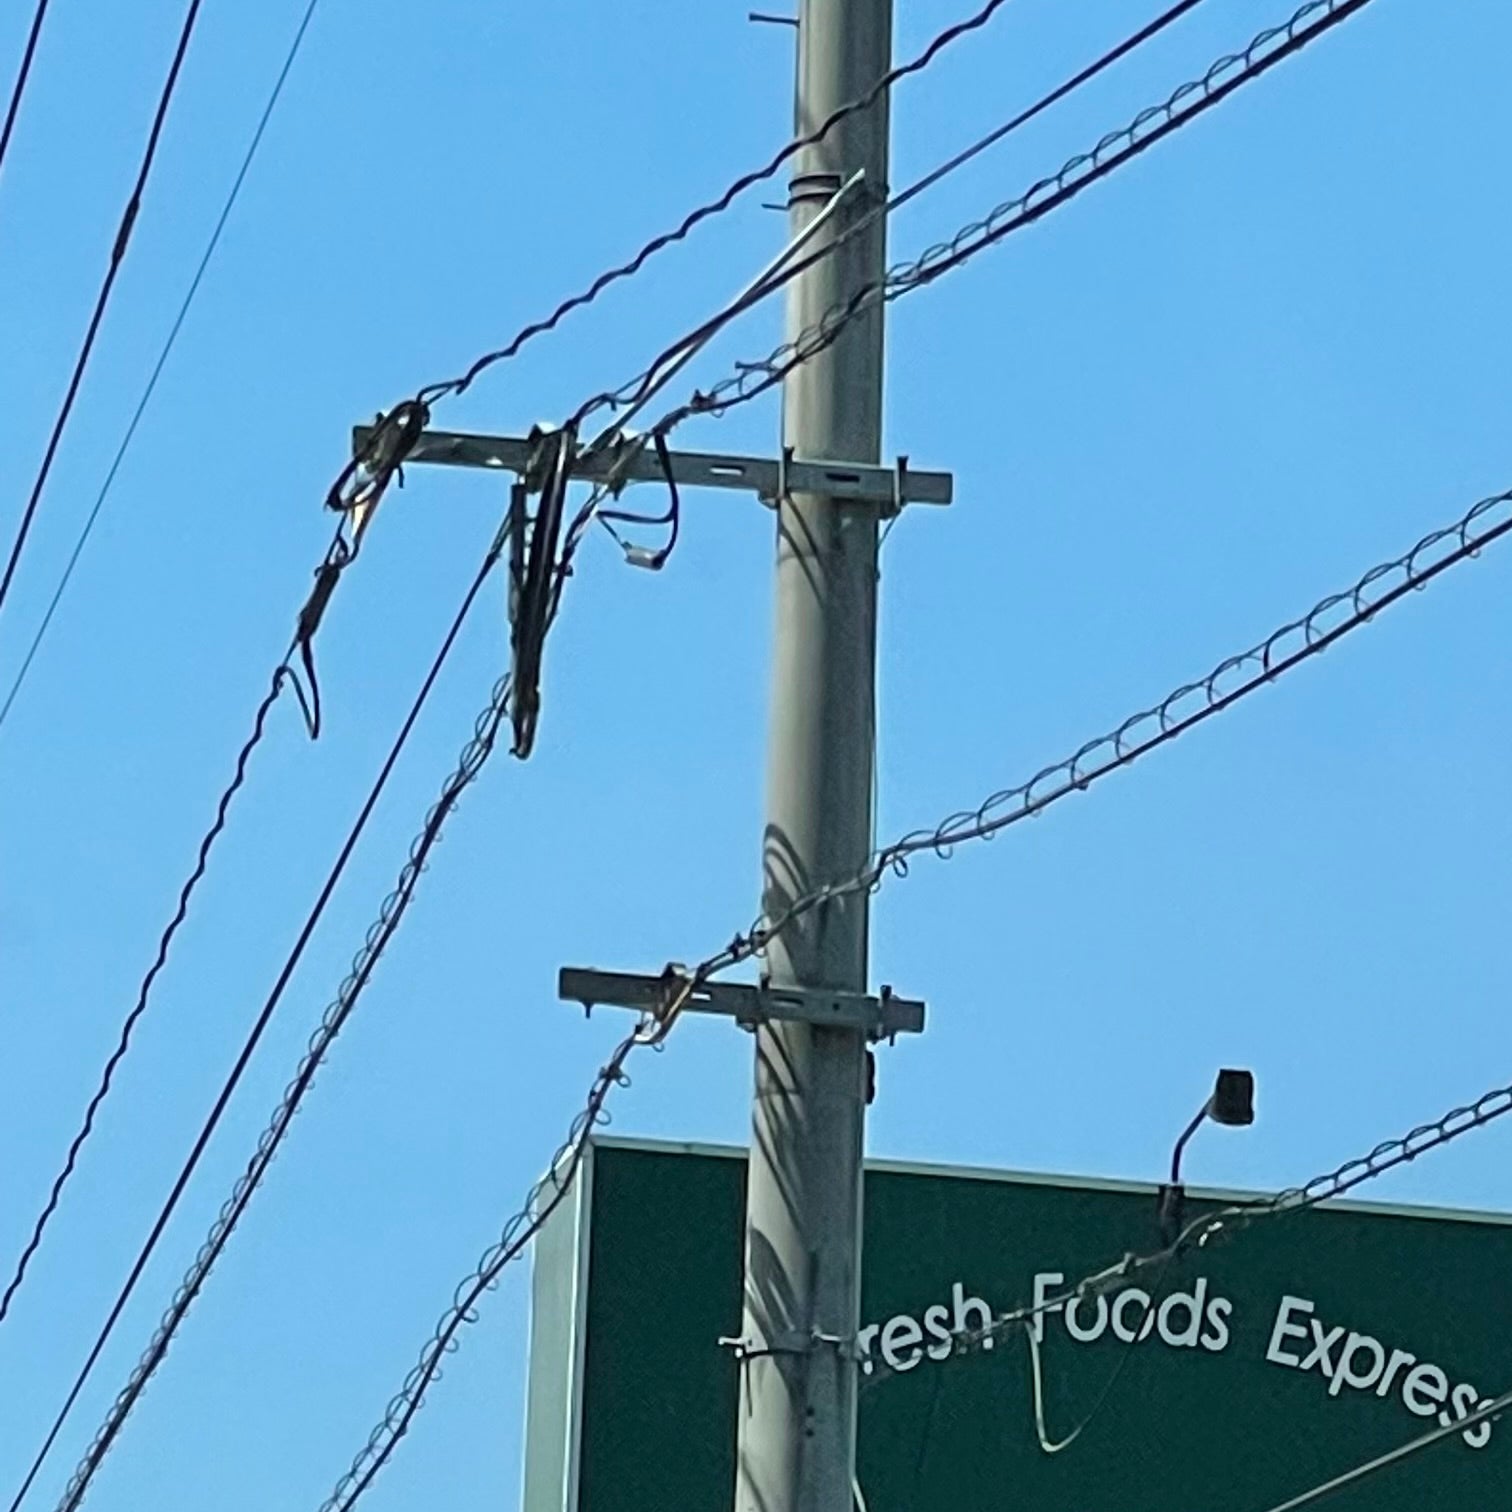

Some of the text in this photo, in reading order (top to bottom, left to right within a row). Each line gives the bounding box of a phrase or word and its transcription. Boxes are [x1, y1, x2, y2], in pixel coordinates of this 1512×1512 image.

[860, 1272, 1500, 1448] resh Foods Express
